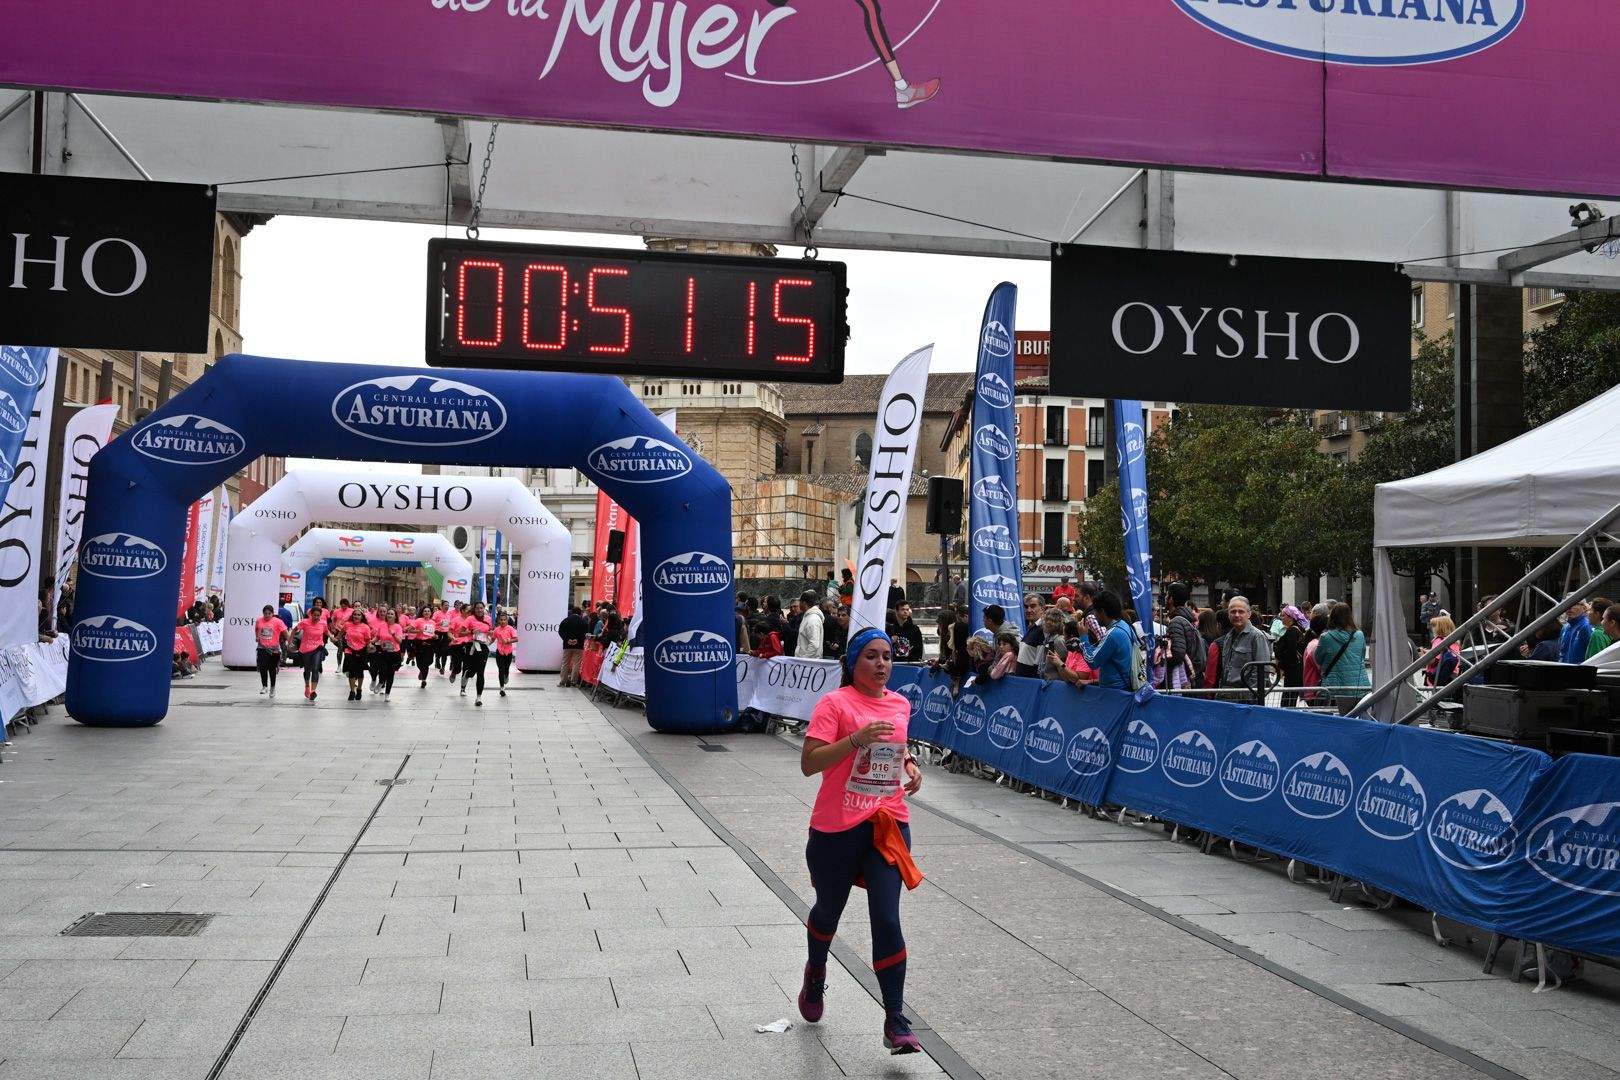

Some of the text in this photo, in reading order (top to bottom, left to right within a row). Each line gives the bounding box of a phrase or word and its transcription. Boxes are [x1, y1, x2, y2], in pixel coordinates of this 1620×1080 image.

[539, 0, 797, 107] Mujer
[1111, 301, 1360, 364] OYSHO
[1014, 340, 1050, 355] IBUR
[373, 393, 489, 407] CENTRAL LECHERA
[345, 393, 494, 430] ASTURIANA
[137, 430, 236, 454] ASTURIANA
[157, 429, 235, 441] CENTRAL LECHERA
[596, 453, 686, 471] ASTURIANA
[338, 482, 473, 512] OYSHO
[860, 392, 917, 601] OYSHO
[254, 509, 297, 520] OYSHO
[509, 516, 548, 526] OYSHO
[82, 547, 160, 570] ASTURIANA
[232, 562, 272, 573] OYSHO
[528, 570, 564, 580] OYSHO
[658, 568, 728, 585] ASTURIANA
[73, 630, 150, 652] ASTURIANA
[659, 646, 729, 663] ASTURIANA
[768, 662, 827, 693] OYSHO
[1164, 746, 1212, 776] ASTURIANA
[1222, 758, 1273, 790] ASTURIANA
[1285, 771, 1346, 806] ASTURIANA
[1358, 785, 1418, 826] ASTURIANA
[1564, 829, 1617, 843] CENTRAL
